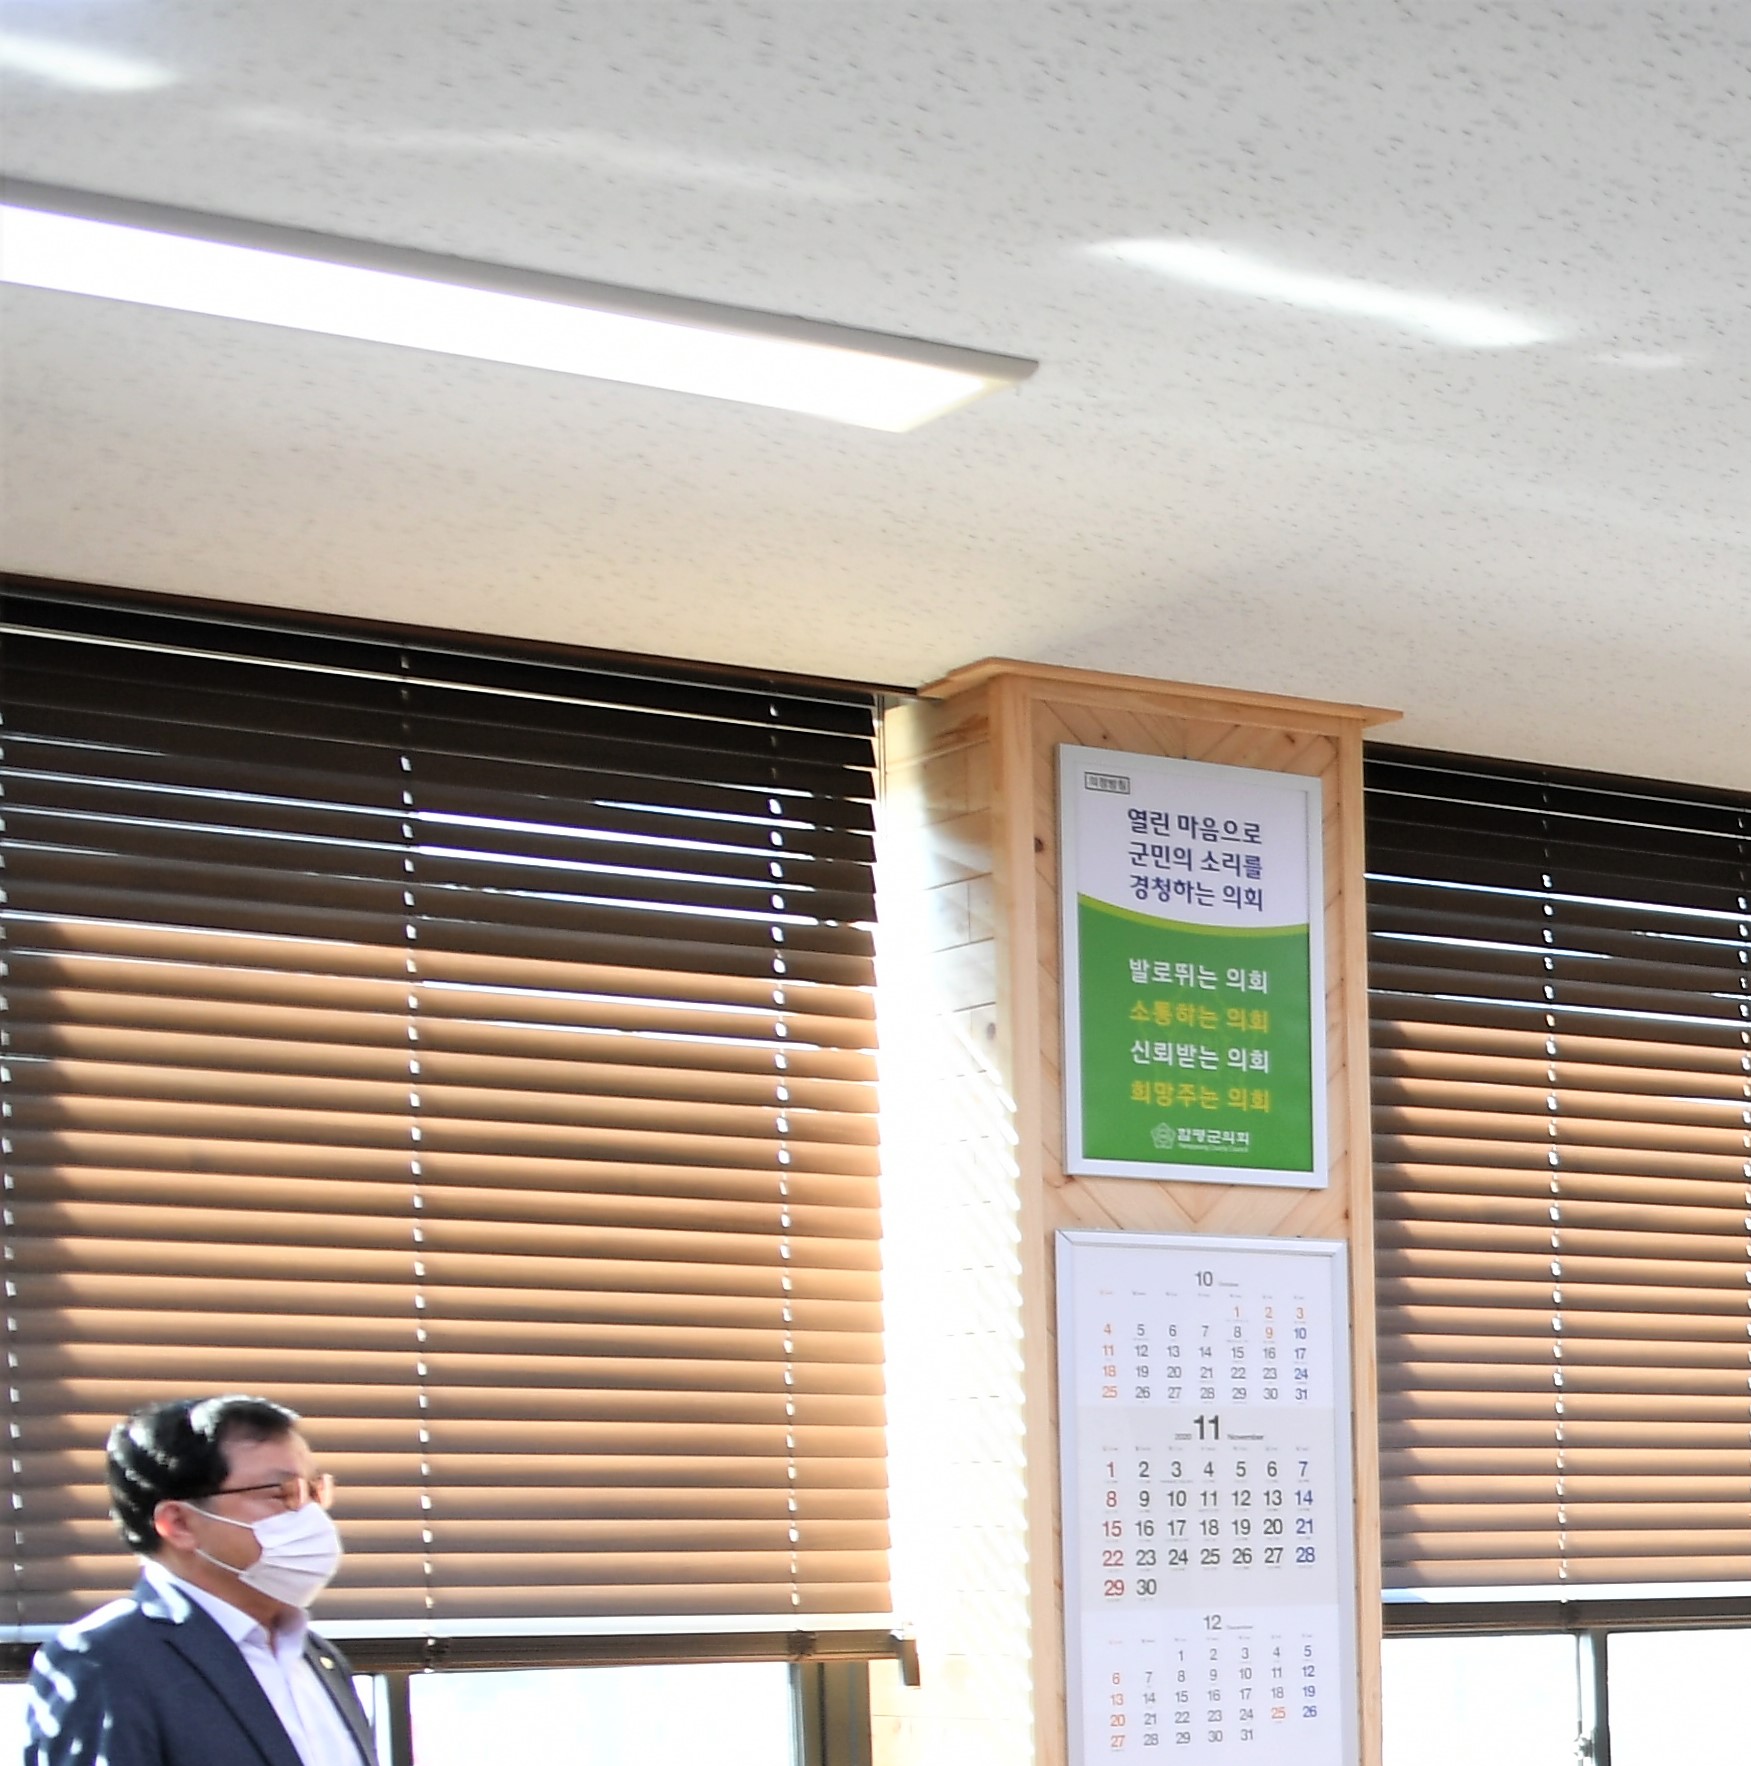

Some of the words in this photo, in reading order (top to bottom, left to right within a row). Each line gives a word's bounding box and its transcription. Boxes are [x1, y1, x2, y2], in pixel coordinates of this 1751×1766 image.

[1127, 808, 1170, 836] 열린
[1177, 815, 1263, 845] 마음으로
[1128, 842, 1193, 872] 군민의
[1200, 850, 1264, 880] 소리를
[1130, 875, 1216, 907] 경청하는
[1222, 886, 1264, 912] 의회
[1129, 958, 1218, 990] 발로뛰는
[1226, 968, 1269, 993] 의회
[1129, 1000, 1219, 1029] 소통하는
[1226, 1009, 1270, 1033] 의회
[1130, 1041, 1219, 1070] 신뢰받는
[1227, 1048, 1270, 1073] 의회
[1130, 1080, 1219, 1110] 희망주는
[1227, 1088, 1270, 1112] 의회
[1195, 1270, 1214, 1287] 10
[1235, 1306, 1240, 1318] 1
[1264, 1306, 1272, 1320] 2
[1297, 1307, 1304, 1320] 3
[1104, 1323, 1112, 1335] 4
[1138, 1323, 1146, 1337] 5
[1169, 1324, 1177, 1338] 6
[1201, 1325, 1209, 1338] 7
[1234, 1325, 1242, 1339] 8
[1266, 1326, 1274, 1339] 9
[1294, 1327, 1307, 1340] 10
[1103, 1344, 1114, 1356] 11
[1135, 1344, 1149, 1358] 12
[1167, 1345, 1181, 1358] 13
[1199, 1346, 1213, 1358] 14
[1232, 1346, 1245, 1359] 15
[1264, 1346, 1277, 1360] 16
[1295, 1347, 1307, 1360] 17
[1103, 1364, 1117, 1378] 18
[1136, 1365, 1150, 1378] 19
[1167, 1365, 1182, 1379] 20
[1201, 1366, 1214, 1379] 21
[1231, 1366, 1247, 1380] 22
[1263, 1367, 1278, 1380] 23
[1295, 1367, 1309, 1381] 24
[1103, 1385, 1118, 1399] 25
[1136, 1385, 1151, 1399] 26
[1168, 1386, 1183, 1399] 27
[1201, 1386, 1216, 1400] 28
[1232, 1387, 1247, 1400] 29
[1264, 1387, 1279, 1400] 30
[1296, 1387, 1308, 1401] 31
[1194, 1414, 1220, 1441] 11
[1107, 1461, 1115, 1478] 1
[1139, 1460, 1150, 1478] 2
[1171, 1460, 1183, 1478] 3
[1204, 1460, 1215, 1478] 4
[1236, 1460, 1247, 1478] 5
[1267, 1460, 1278, 1478] 6
[1299, 1460, 1309, 1478] 7
[1106, 1490, 1118, 1508] 8
[1139, 1490, 1151, 1508] 9
[1167, 1489, 1187, 1508] 10
[1200, 1490, 1218, 1507] 11
[1232, 1489, 1252, 1507] 12
[1264, 1488, 1283, 1507] 13
[1295, 1489, 1314, 1506] 14
[1103, 1519, 1123, 1538] 15
[1135, 1519, 1155, 1537] 16
[1168, 1519, 1187, 1537] 17
[1200, 1518, 1220, 1536] 18
[1232, 1518, 1252, 1536] 19
[1264, 1517, 1284, 1535] 20
[1296, 1517, 1314, 1535] 21
[1102, 1549, 1125, 1567] 22
[1136, 1548, 1157, 1567] 23
[1168, 1548, 1189, 1566] 24
[1200, 1547, 1221, 1566] 25
[1232, 1547, 1253, 1565] 26
[1264, 1546, 1285, 1564] 27
[1296, 1546, 1316, 1564] 28
[1104, 1578, 1125, 1597] 29
[1136, 1578, 1158, 1596] 30
[1204, 1614, 1223, 1631] 12
[1179, 1649, 1184, 1662] 1
[1209, 1648, 1217, 1662] 2
[1242, 1647, 1250, 1660] 3
[1273, 1646, 1281, 1658] 4
[1304, 1644, 1312, 1658] 5
[1113, 1672, 1121, 1685] 6
[1144, 1671, 1152, 1684] 7
[1178, 1669, 1186, 1683] 8
[1210, 1668, 1218, 1682] 9
[1240, 1667, 1253, 1680] 10
[1272, 1666, 1282, 1679] 11
[1302, 1664, 1316, 1678] 12
[1111, 1693, 1124, 1706] 13
[1143, 1692, 1156, 1705] 14
[1176, 1690, 1189, 1703] 15
[1208, 1688, 1221, 1702] 16
[1240, 1687, 1253, 1700] 17
[1272, 1686, 1285, 1699] 18
[1303, 1684, 1316, 1698] 19
[1111, 1713, 1126, 1727] 20
[1144, 1712, 1157, 1726] 21
[1175, 1710, 1191, 1724] 22
[1208, 1709, 1223, 1723] 23
[1240, 1708, 1254, 1721] 24
[1272, 1706, 1286, 1720] 25
[1303, 1705, 1318, 1719] 26
[1111, 1734, 1126, 1748] 27
[1144, 1732, 1160, 1747] 28
[1176, 1731, 1191, 1745] 29
[1208, 1729, 1224, 1743] 30
[1241, 1728, 1254, 1742] 31
